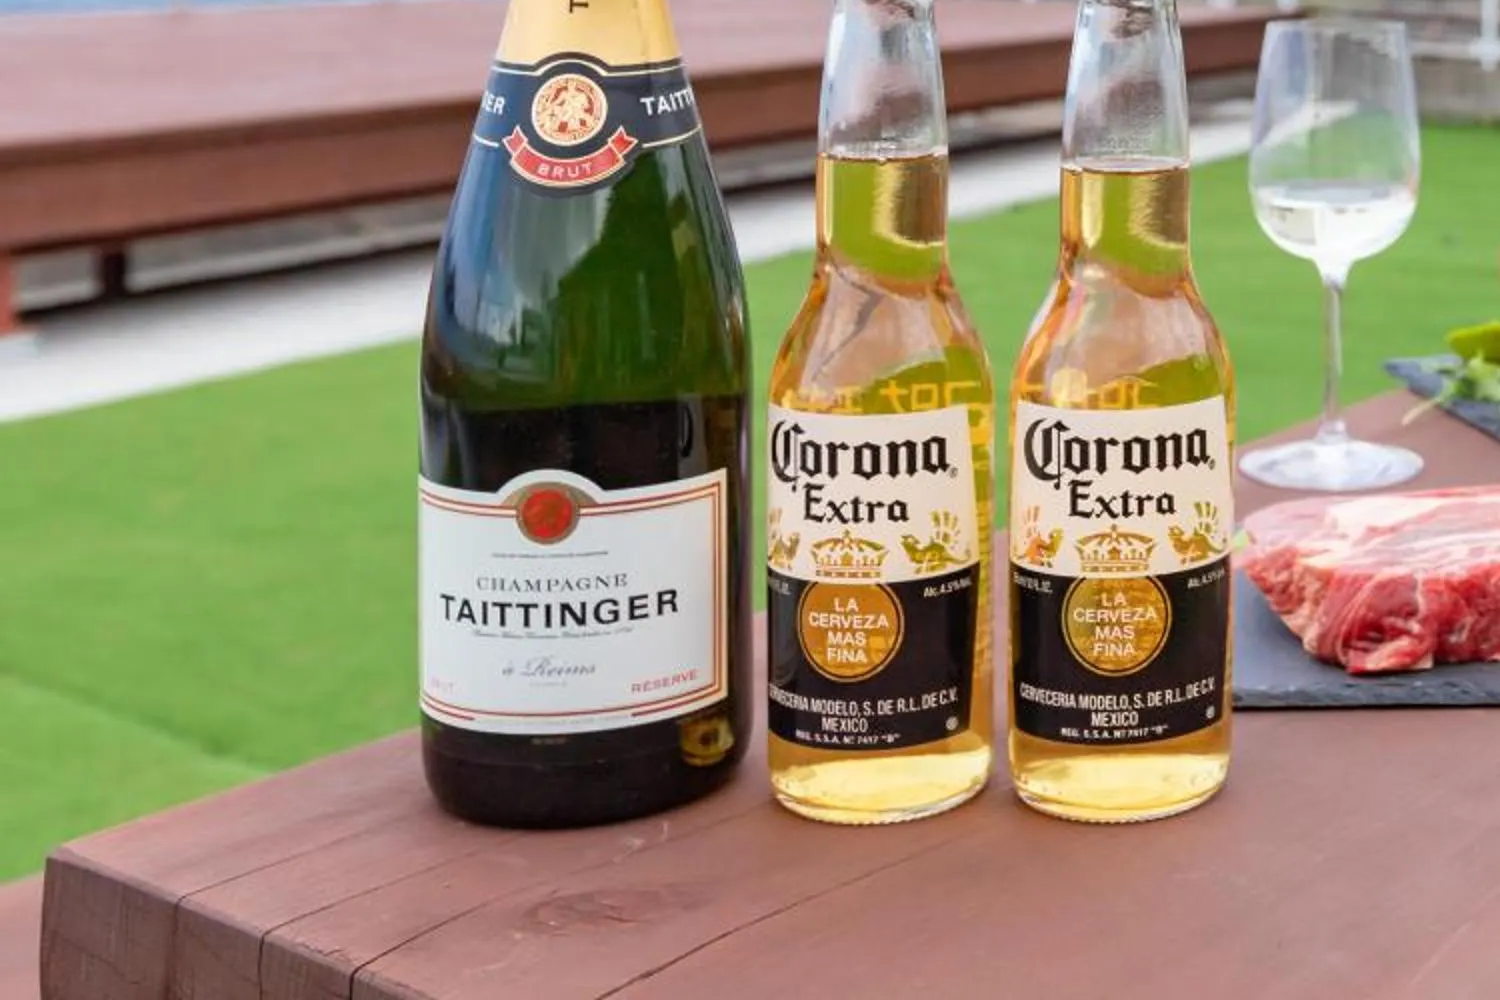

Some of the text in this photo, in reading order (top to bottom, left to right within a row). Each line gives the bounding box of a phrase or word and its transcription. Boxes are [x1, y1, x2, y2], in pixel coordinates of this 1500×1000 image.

[537, 160, 592, 180] BRUT
[771, 419, 950, 493] Corona
[1023, 417, 1211, 490] Corona
[802, 483, 910, 523] Extra
[1068, 480, 1177, 518] Extra
[477, 573, 628, 594] CHAMPAGNE
[834, 597, 859, 612] LA
[1101, 592, 1127, 606] LA
[440, 588, 679, 628] TAITTINGER
[1073, 606, 1158, 623] CERVEZA
[808, 613, 889, 629] CERVEZA
[826, 631, 867, 646] MAS
[1095, 625, 1135, 640] MAS
[826, 648, 867, 664] FINA
[1093, 642, 1136, 657] FINA
[863, 700, 875, 716] S.
[878, 699, 895, 715] DE
[922, 693, 938, 709] DE
[1147, 692, 1163, 707] DE
[821, 717, 869, 733] MEXICO
[1091, 711, 1139, 727] MEXICO
